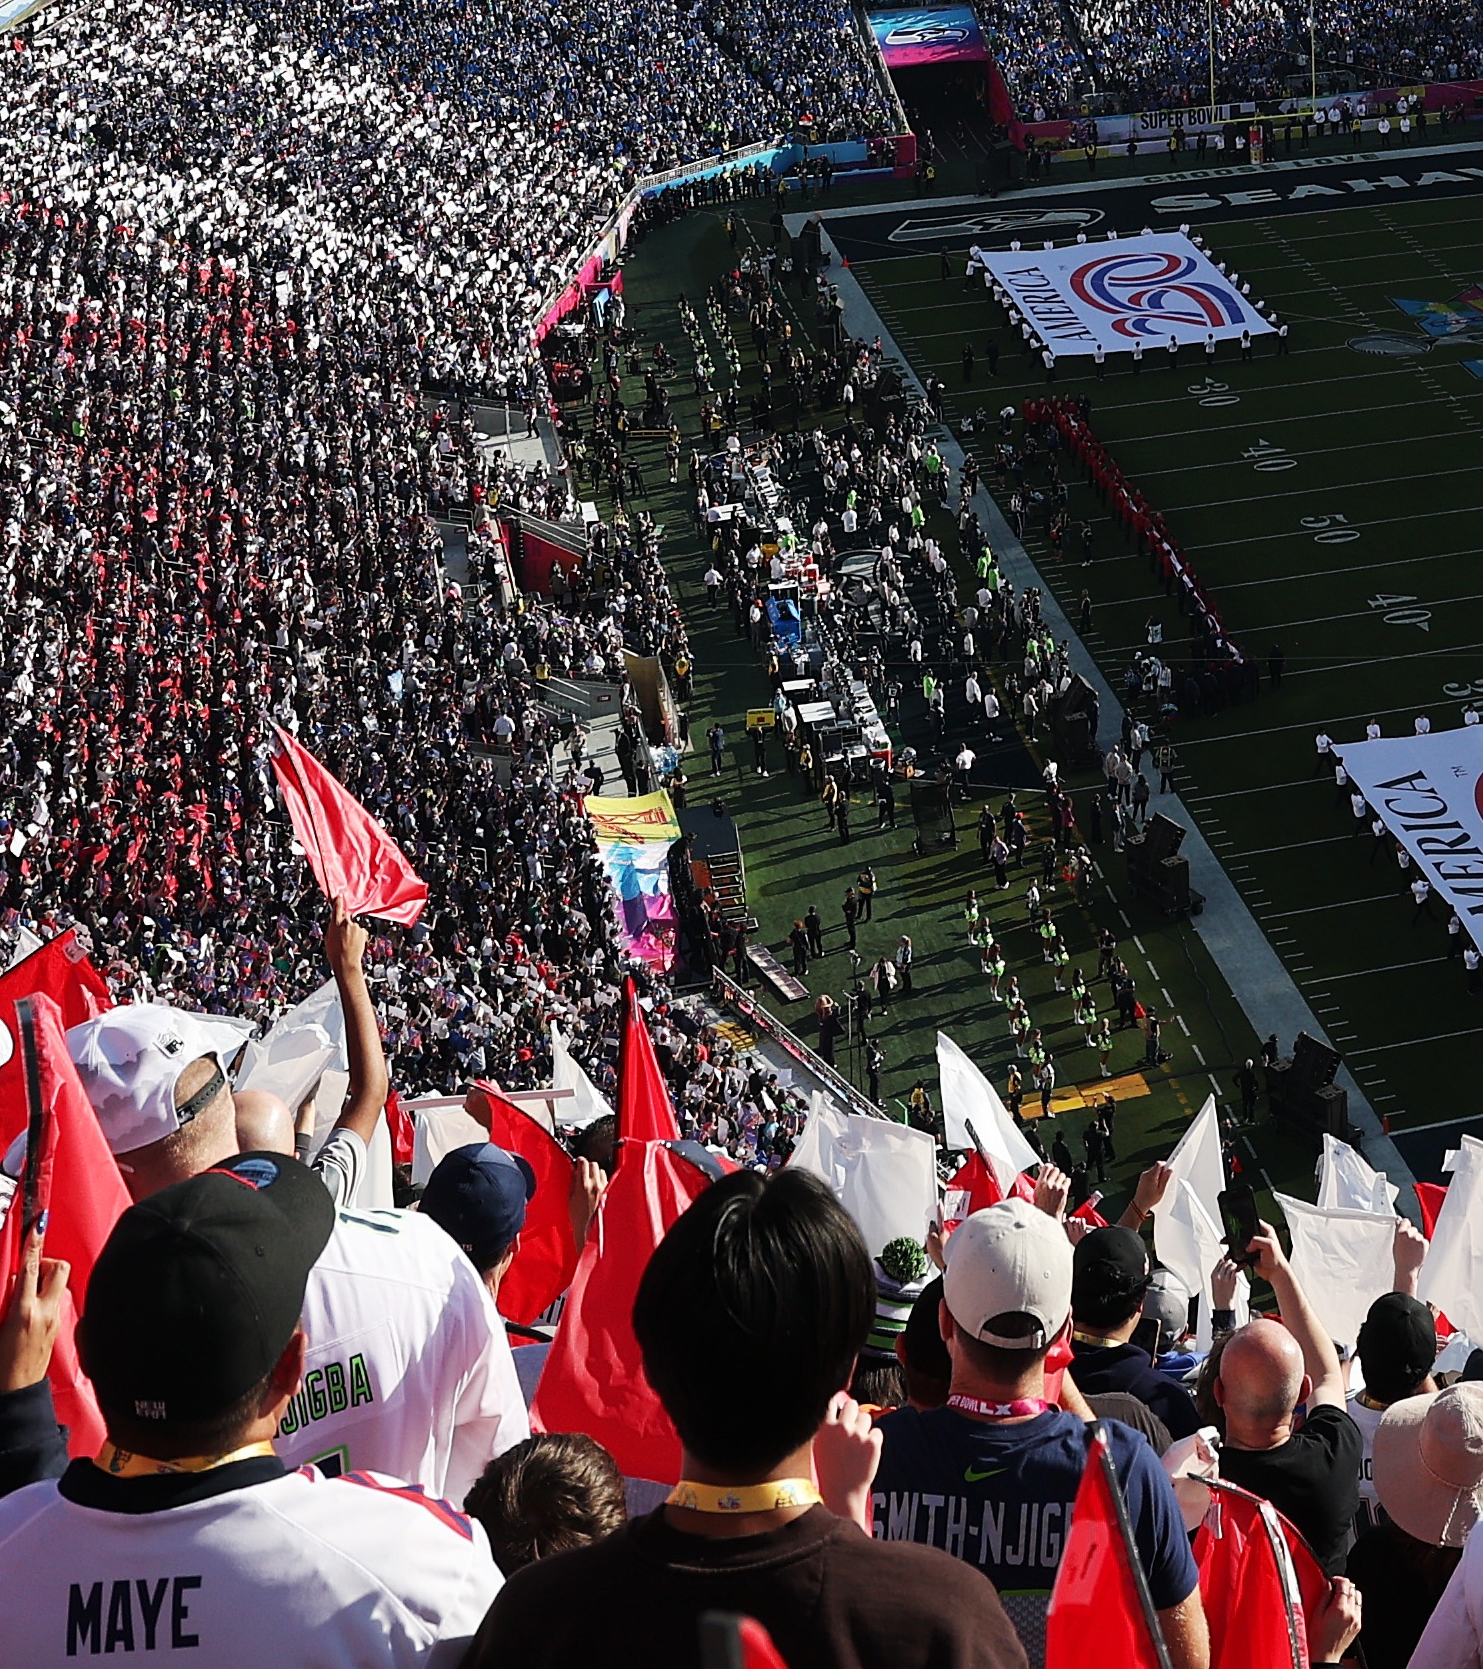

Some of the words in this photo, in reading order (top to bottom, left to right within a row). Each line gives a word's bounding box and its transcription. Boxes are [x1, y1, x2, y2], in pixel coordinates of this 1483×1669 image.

[1140, 109, 1181, 131] SUPER
[1011, 266, 1098, 342] AMERICA
[1187, 382, 1240, 407] 30
[1241, 445, 1298, 473] 40
[1300, 513, 1361, 544] 50
[1367, 592, 1432, 624] 40
[959, 1395, 979, 1411] BOWL
[980, 1402, 1012, 1416] LX
[870, 1491, 1074, 1569] SMITH-NJIG
[65, 1574, 204, 1655] MAYE
